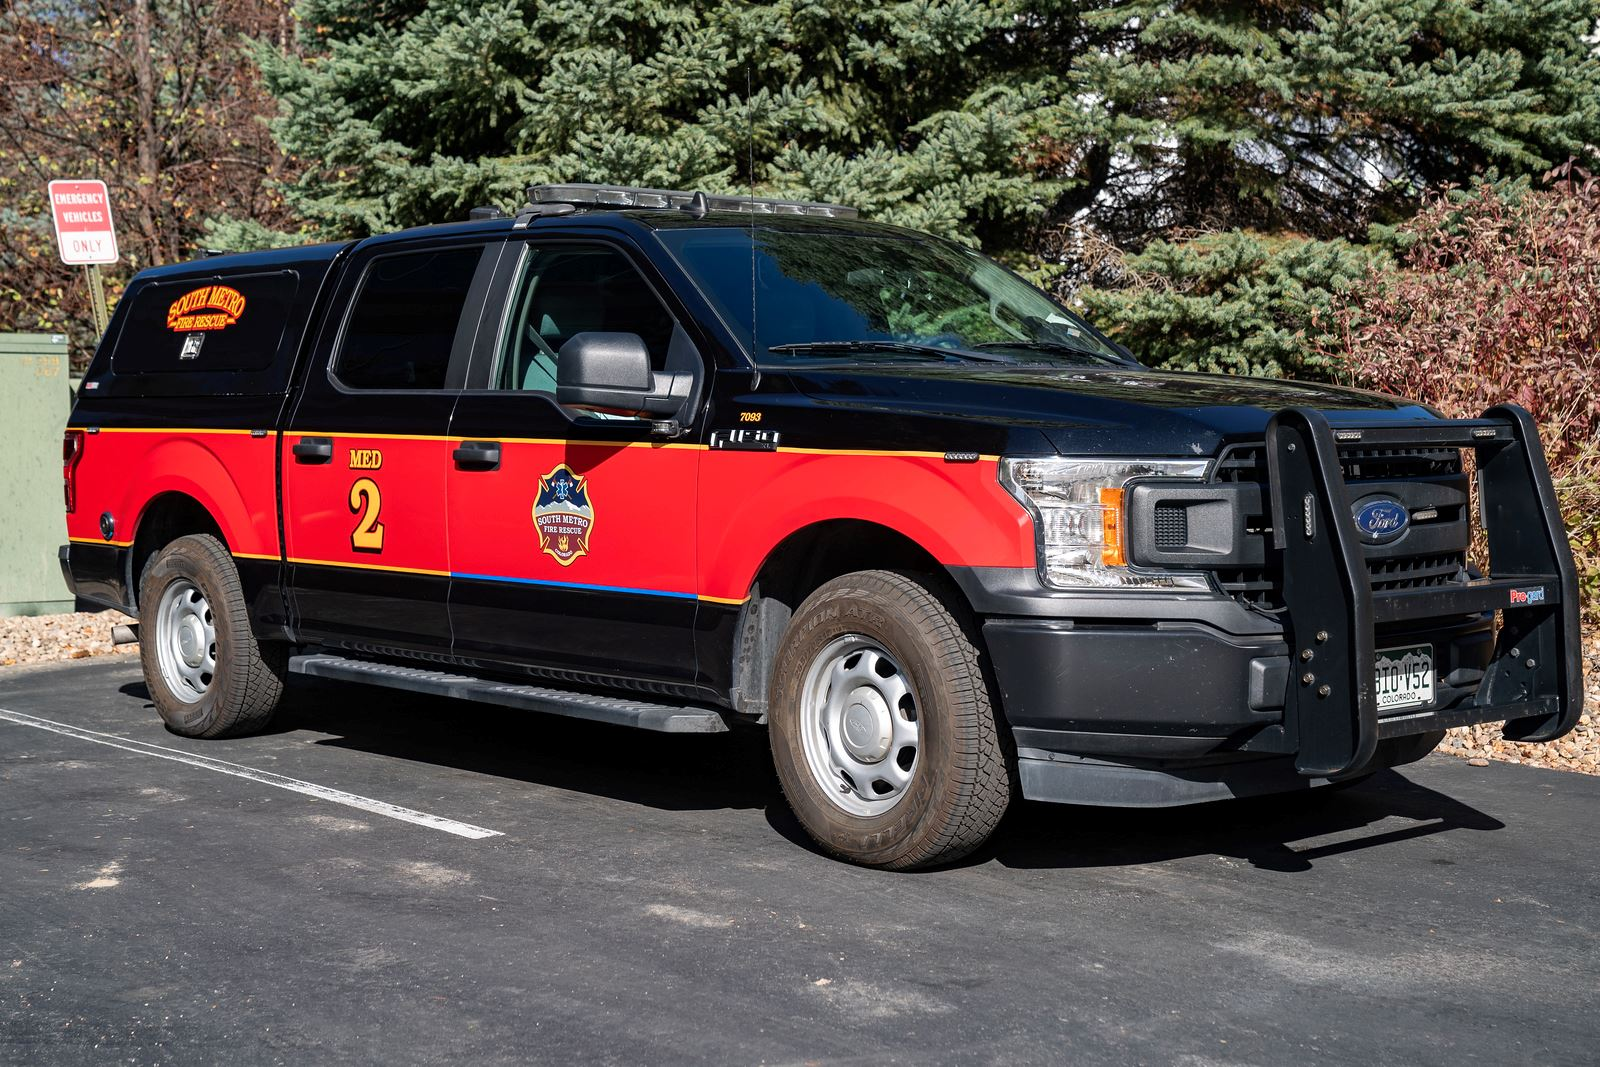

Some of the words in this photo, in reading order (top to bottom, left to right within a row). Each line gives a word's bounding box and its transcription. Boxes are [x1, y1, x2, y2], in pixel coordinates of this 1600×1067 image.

[54, 193, 104, 205] EMERGENCY
[62, 211, 103, 223] VEHICLES
[73, 240, 102, 253] ONLY
[167, 286, 212, 320] SOUTH
[206, 286, 246, 319] METRO
[174, 316, 195, 332] FIRE
[192, 313, 228, 331] RESCUE
[740, 412, 762, 422] 7093
[349, 448, 383, 470] MED
[348, 476, 385, 554] 2
[538, 515, 561, 526] SOUTH
[562, 515, 588, 528] METRO
[1369, 508, 1399, 530] Ford
[544, 525, 558, 533] FIRE
[558, 526, 582, 535] RESCUE
[1382, 691, 1417, 704] COLORADO
